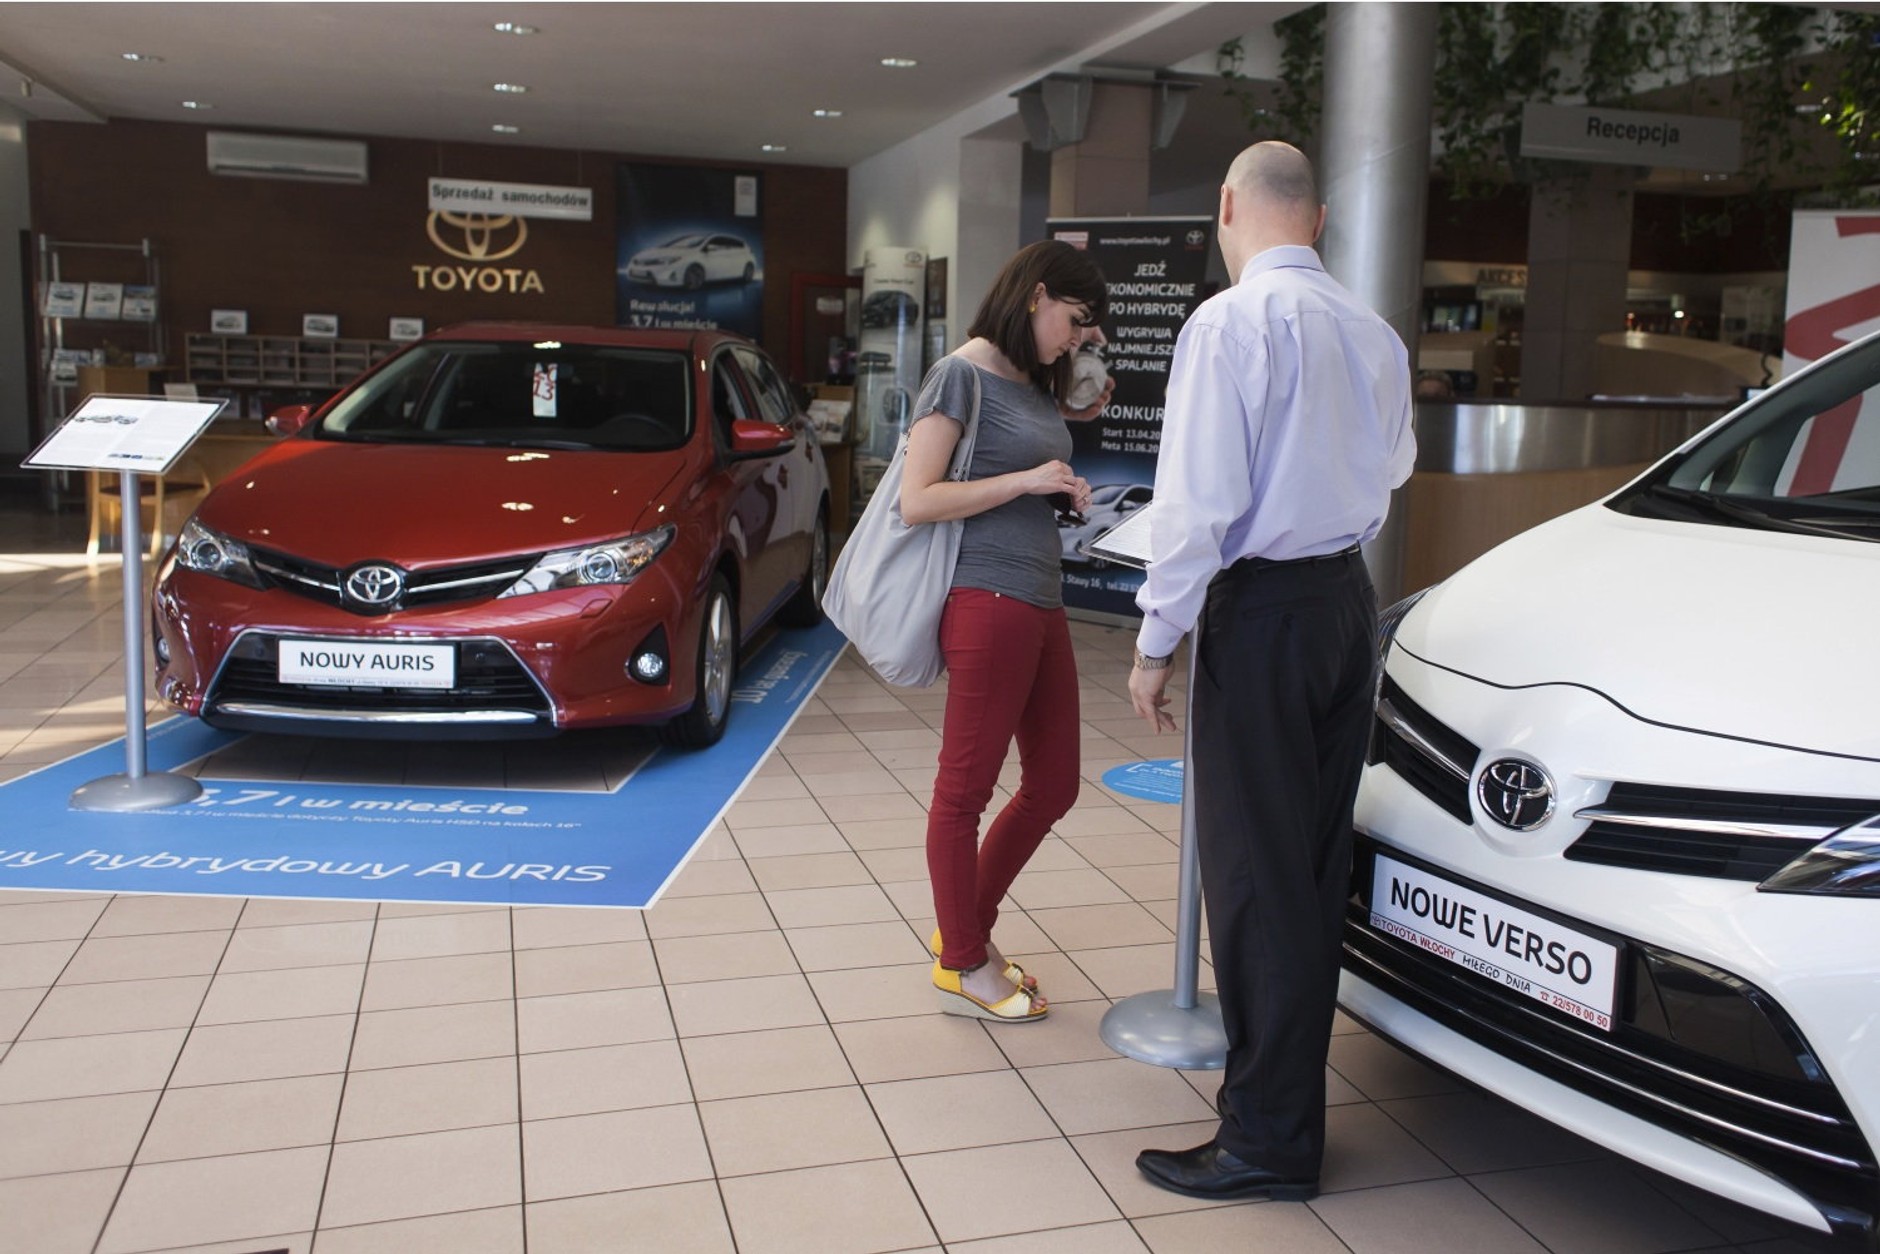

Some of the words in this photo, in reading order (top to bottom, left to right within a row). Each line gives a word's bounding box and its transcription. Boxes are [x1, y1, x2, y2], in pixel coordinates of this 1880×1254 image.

[1587, 116, 1680, 147] Recepcja
[432, 183, 494, 200] Sprzedaż
[501, 190, 588, 206] samochodów
[1134, 260, 1168, 276] JEDŹ
[411, 265, 544, 294] TOYOTA
[1477, 268, 1527, 288] AKCES
[1108, 302, 1125, 315] PO
[1126, 303, 1187, 319] HYBRYDĘ
[1116, 327, 1172, 338] WYGRYWA
[1115, 359, 1167, 371] SPALANIE
[1101, 405, 1165, 421] KONKUR
[1102, 427, 1123, 438] Start
[1126, 429, 1161, 440] 13.04.20
[1101, 441, 1121, 451] Meta
[1124, 442, 1159, 454] 15.06.20
[300, 651, 365, 669] NOWY
[370, 654, 435, 672] AURIS
[301, 798, 344, 808] w
[349, 799, 529, 815] mieście
[65, 850, 410, 880] hybrydowy
[414, 861, 612, 881] AURIS
[1391, 876, 1476, 939] NOWE
[1483, 913, 1593, 985] VERSO
[1381, 921, 1418, 944] TOYOTA
[1419, 936, 1456, 960] WŁOCHY
[1462, 953, 1501, 979] MIŁEGO
[1506, 973, 1531, 993] DNIA
[1552, 992, 1582, 1017] 22/578
[1583, 1008, 1595, 1022] 00
[1596, 1013, 1608, 1028] 50
